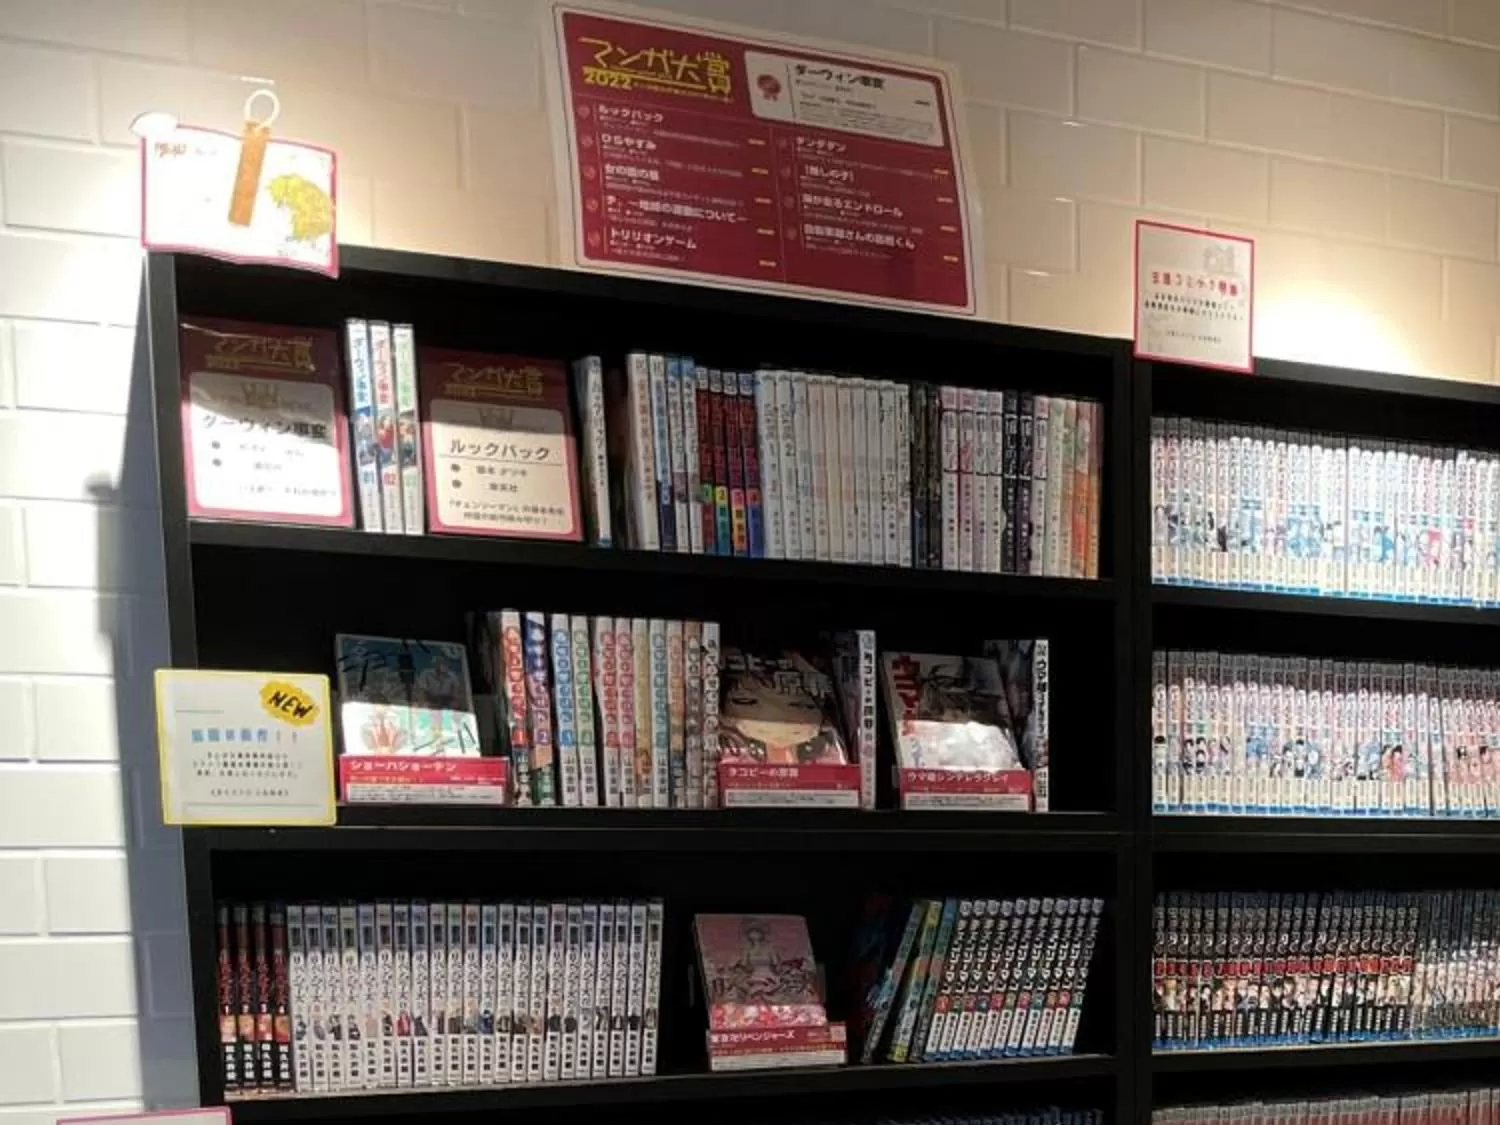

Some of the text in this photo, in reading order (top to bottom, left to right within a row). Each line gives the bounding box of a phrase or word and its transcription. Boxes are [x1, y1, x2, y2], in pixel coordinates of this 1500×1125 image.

[579, 37, 732, 94] マンガ大賞
[583, 67, 632, 90] 2022
[450, 439, 551, 461] ルックバック
[267, 690, 314, 719] NEW
[351, 760, 457, 772] ショーハショーテン
